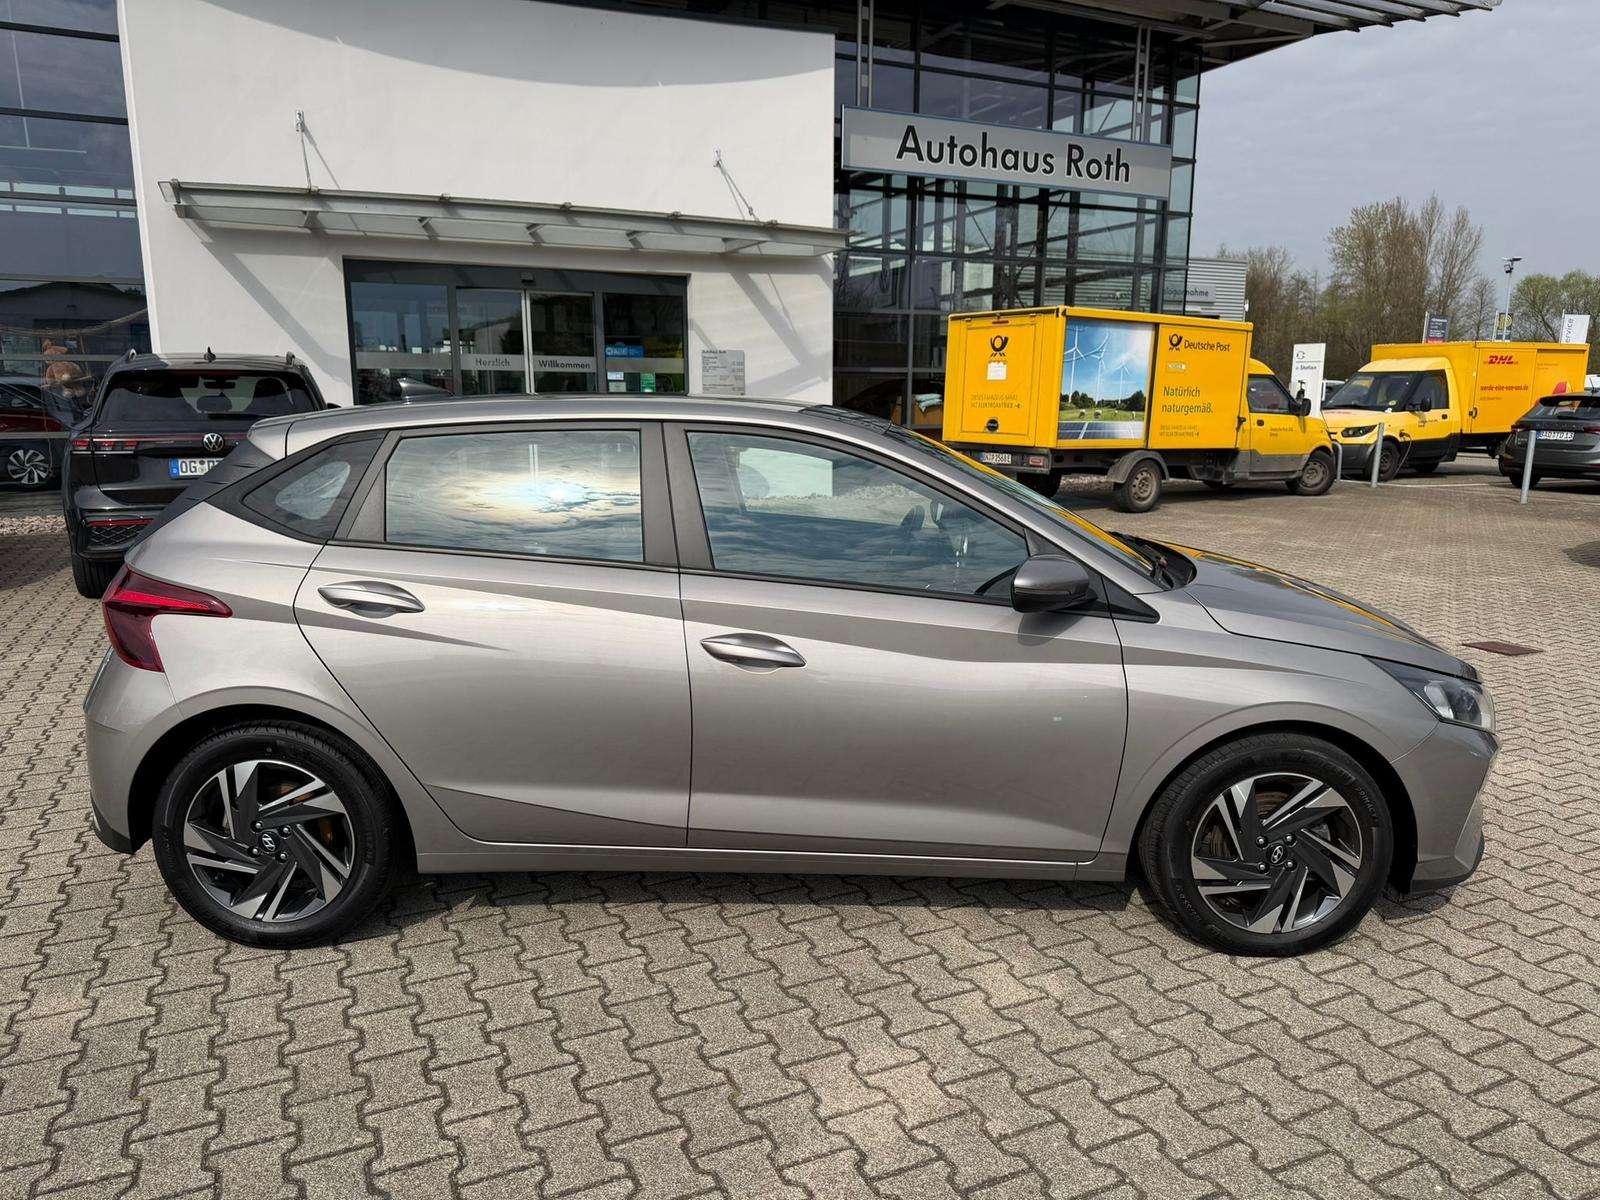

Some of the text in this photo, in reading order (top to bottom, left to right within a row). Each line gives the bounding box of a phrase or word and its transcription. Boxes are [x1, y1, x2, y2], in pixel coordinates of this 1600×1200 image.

[896, 124, 1131, 183] Autohaus Roth
[1184, 339, 1230, 352] Deutsche Post
[475, 357, 510, 367] Herzlich
[538, 359, 590, 369] Willkommen
[1488, 355, 1514, 365] DHL
[1163, 386, 1200, 398] Natürlich
[1161, 402, 1213, 416] naturgemäß.
[180, 460, 198, 473] OG
